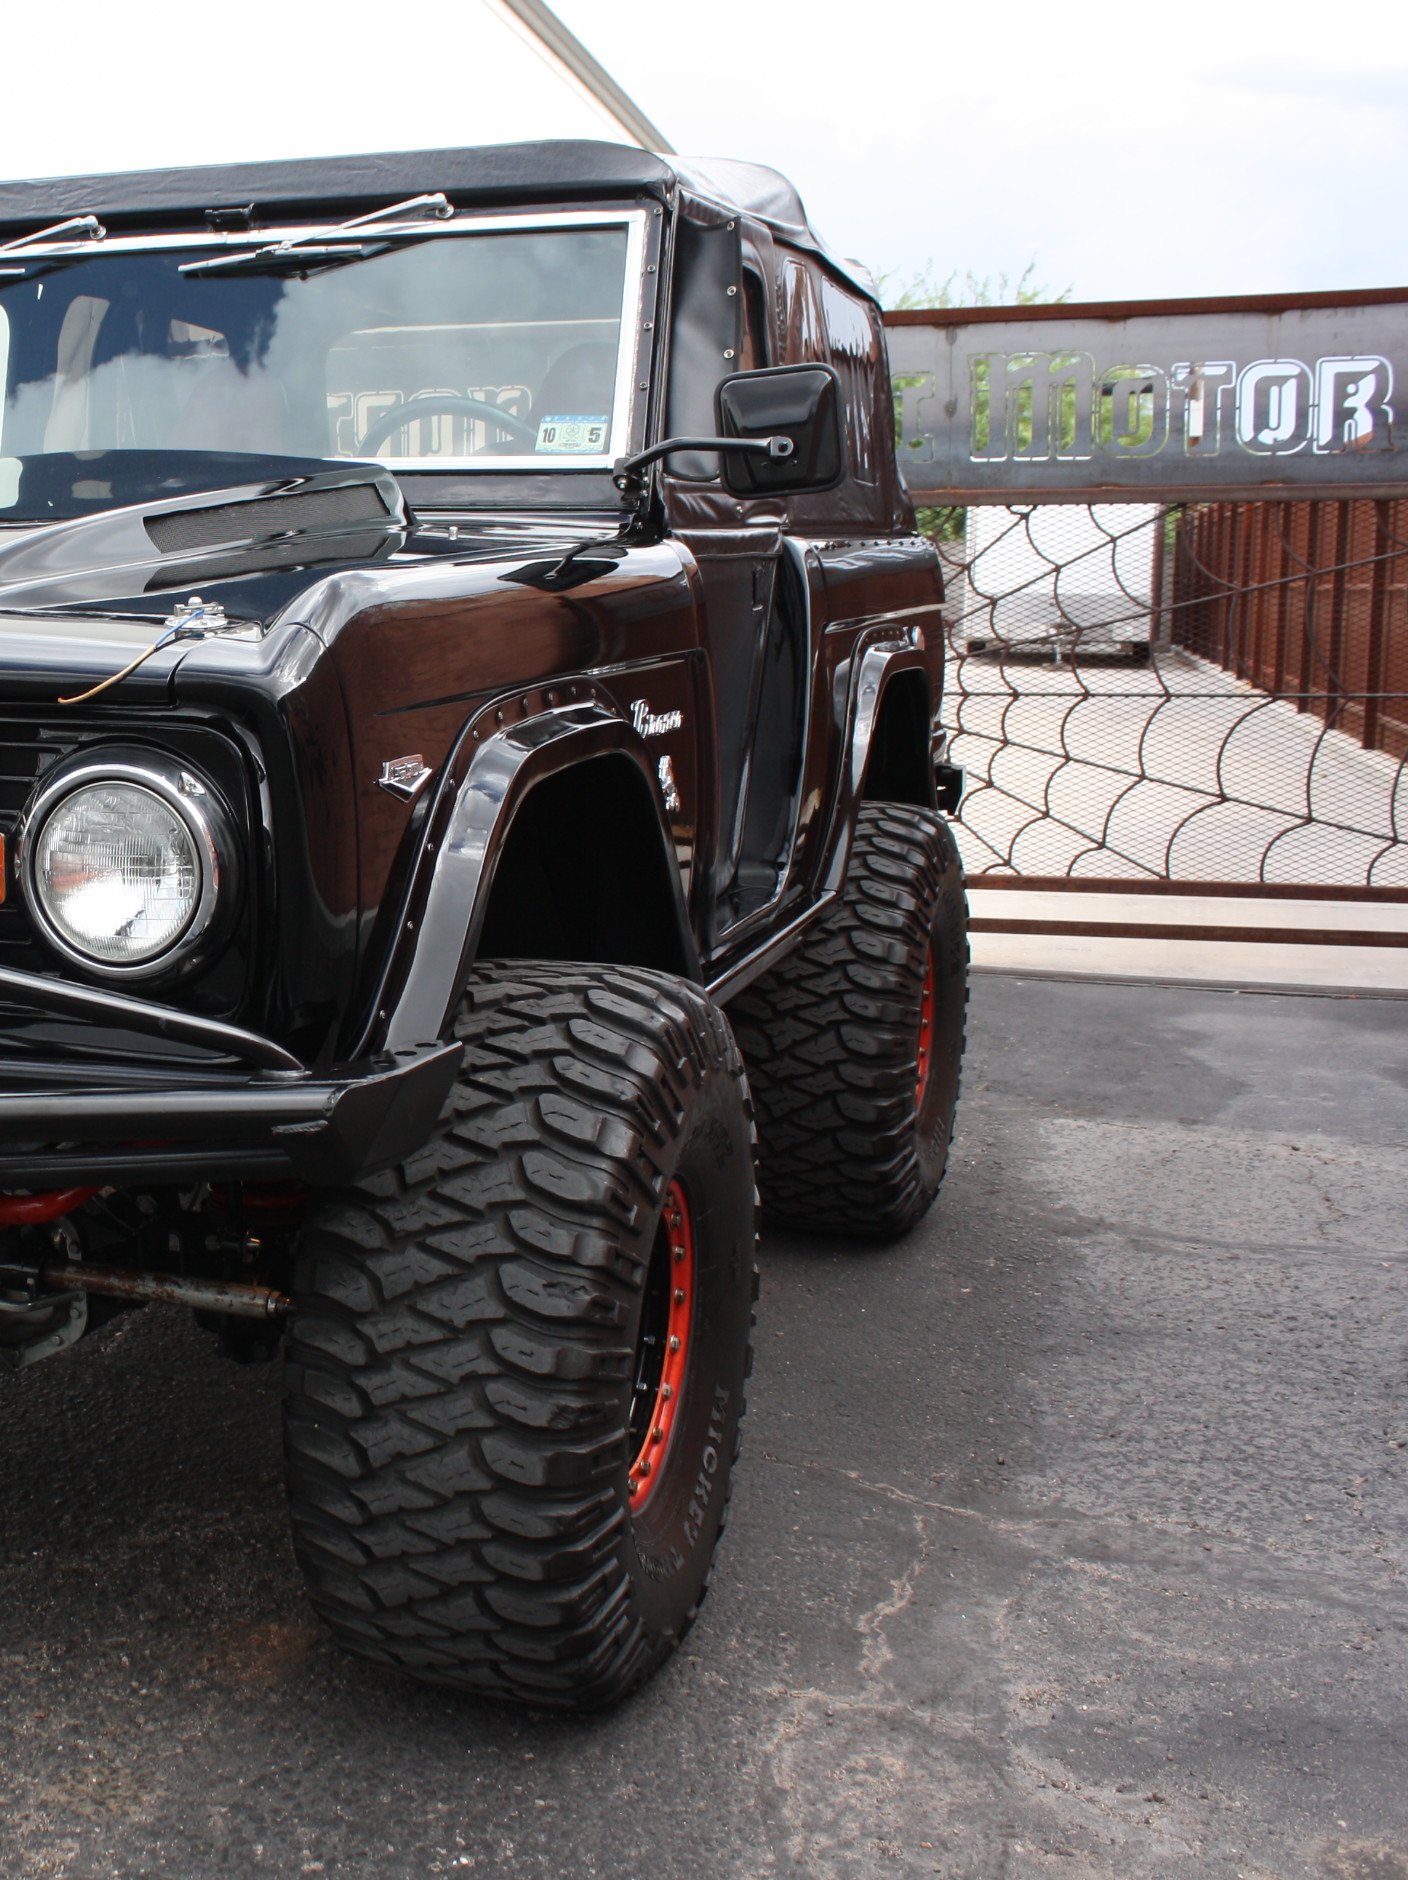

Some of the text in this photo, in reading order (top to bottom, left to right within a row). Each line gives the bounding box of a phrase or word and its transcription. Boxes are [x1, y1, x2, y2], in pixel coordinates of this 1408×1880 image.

[968, 350, 1394, 463] MOTOR
[542, 427, 556, 443] 10
[588, 427, 602, 443] 5
